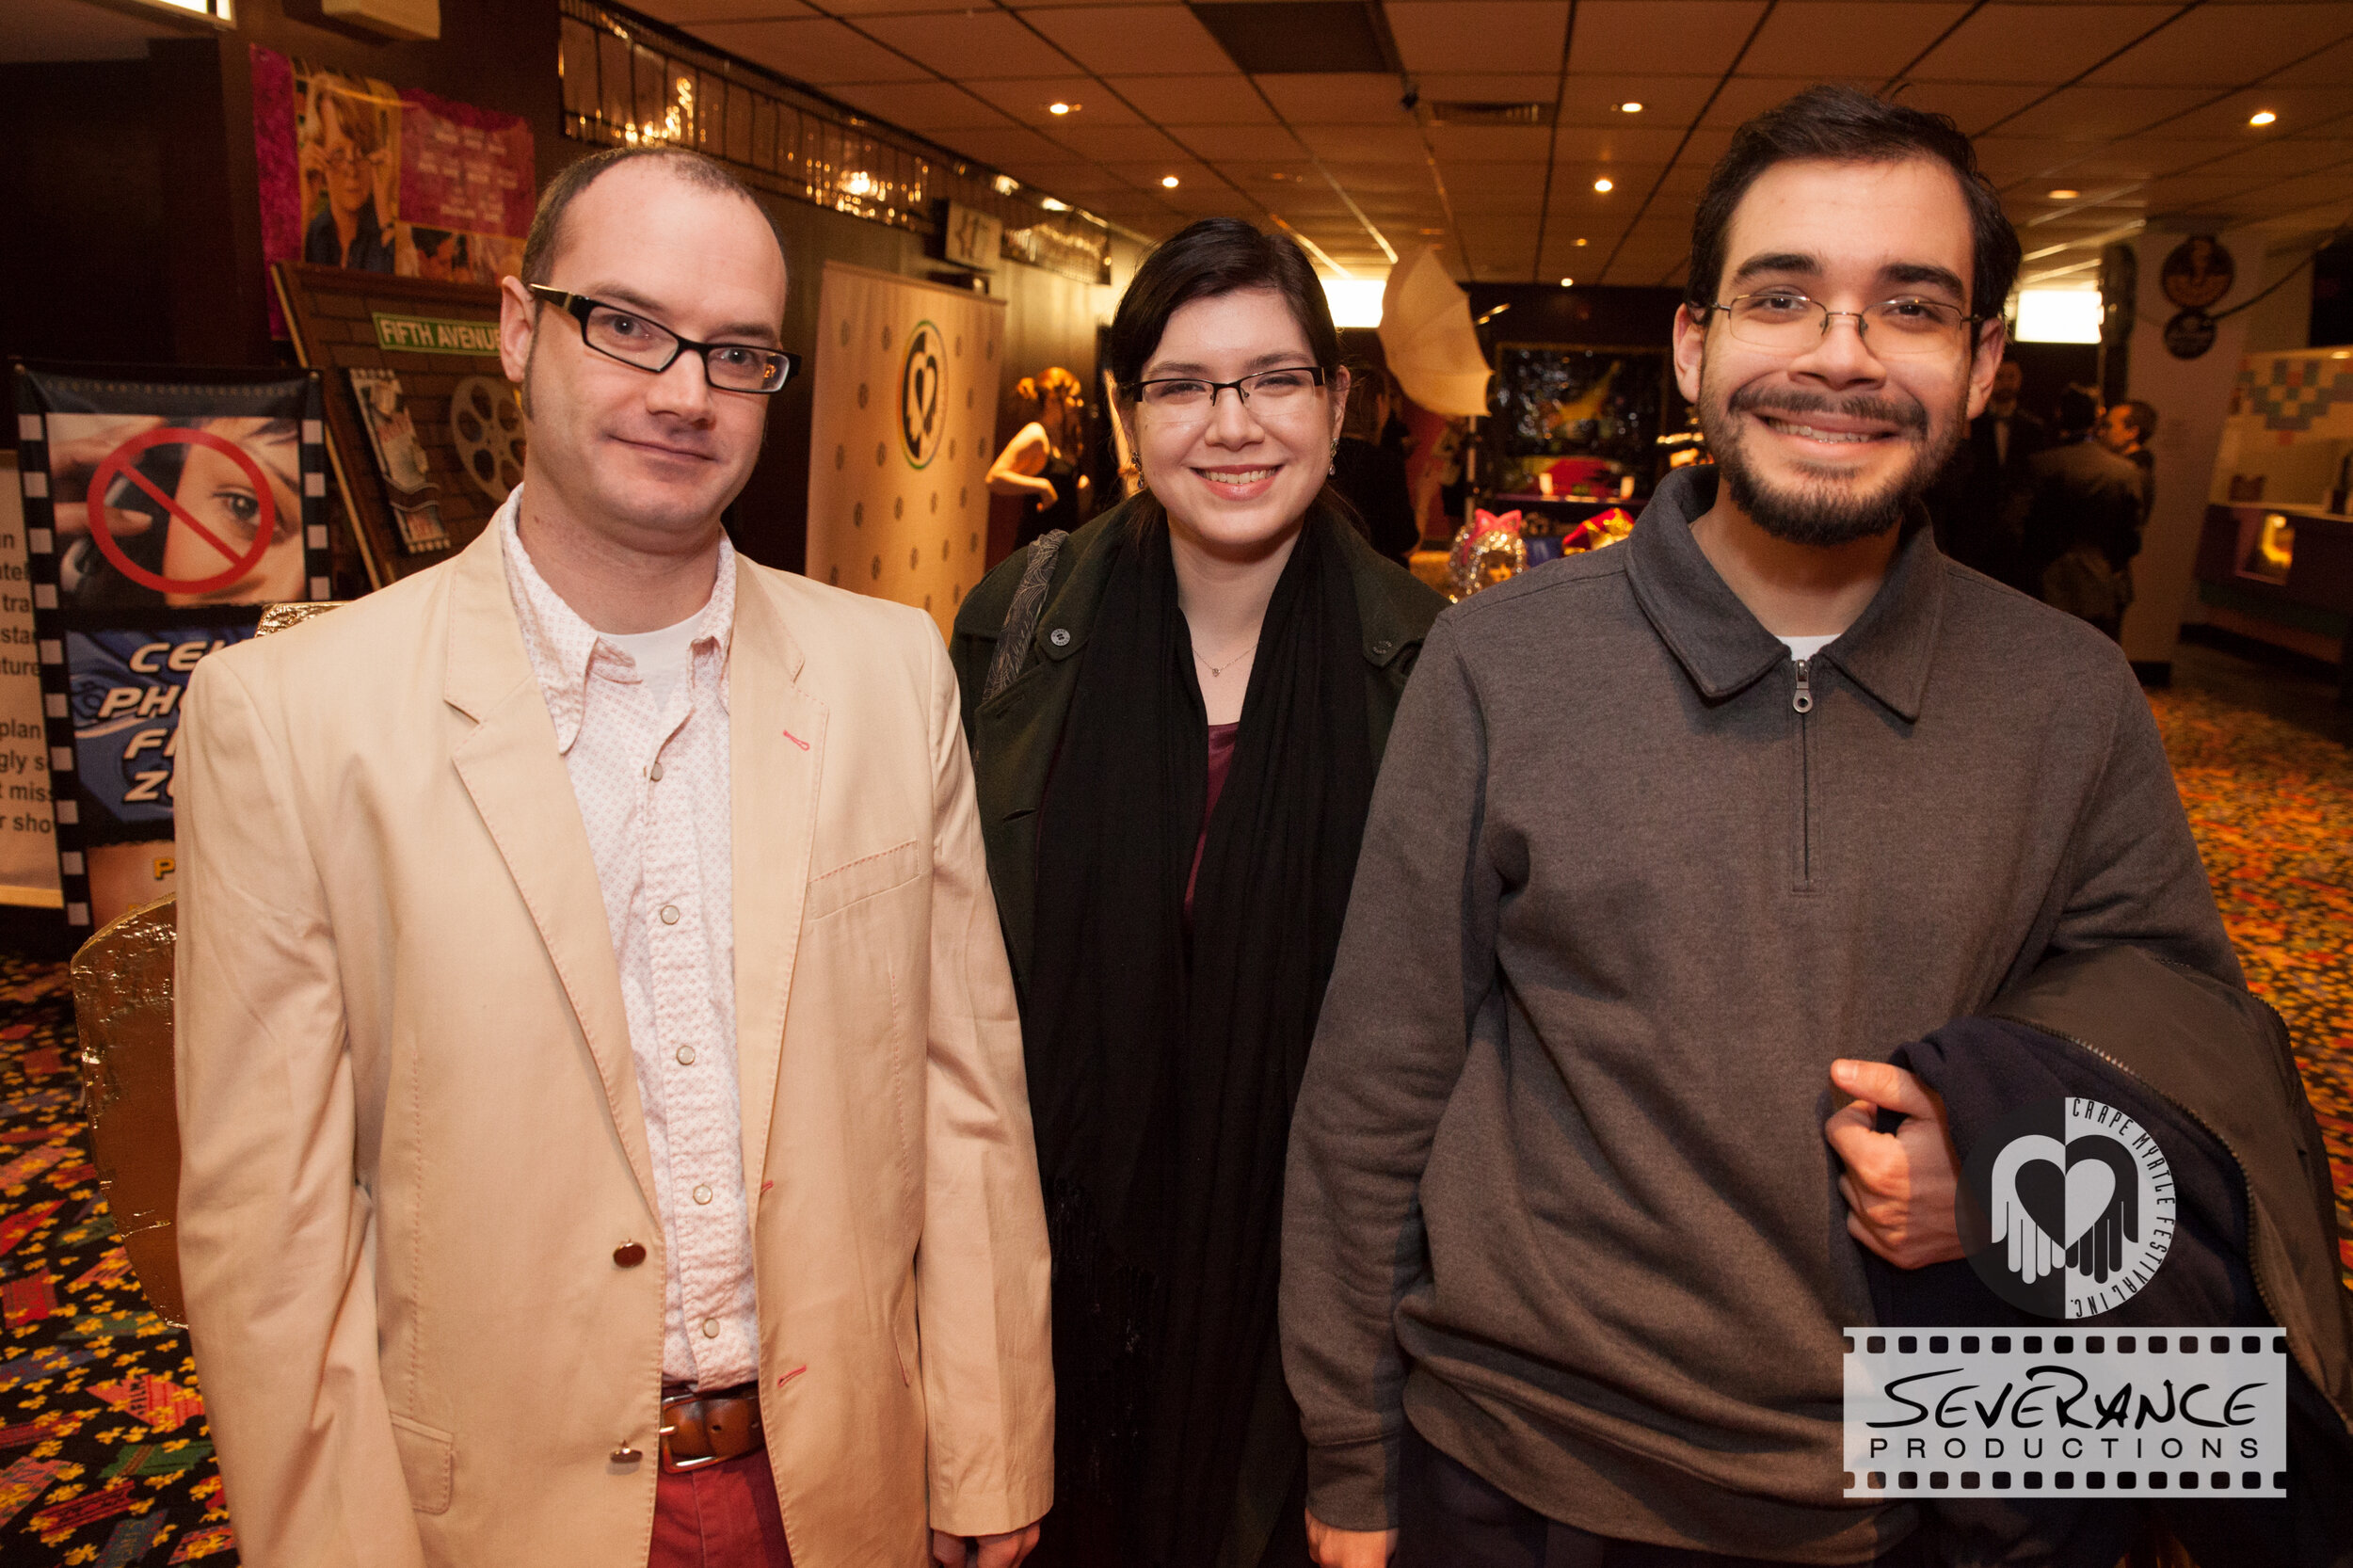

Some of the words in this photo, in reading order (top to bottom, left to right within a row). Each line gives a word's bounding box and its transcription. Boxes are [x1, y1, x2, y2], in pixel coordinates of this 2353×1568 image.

[380, 319, 435, 347] FIFTH
[98, 684, 186, 717] PH
[124, 770, 174, 801] Z
